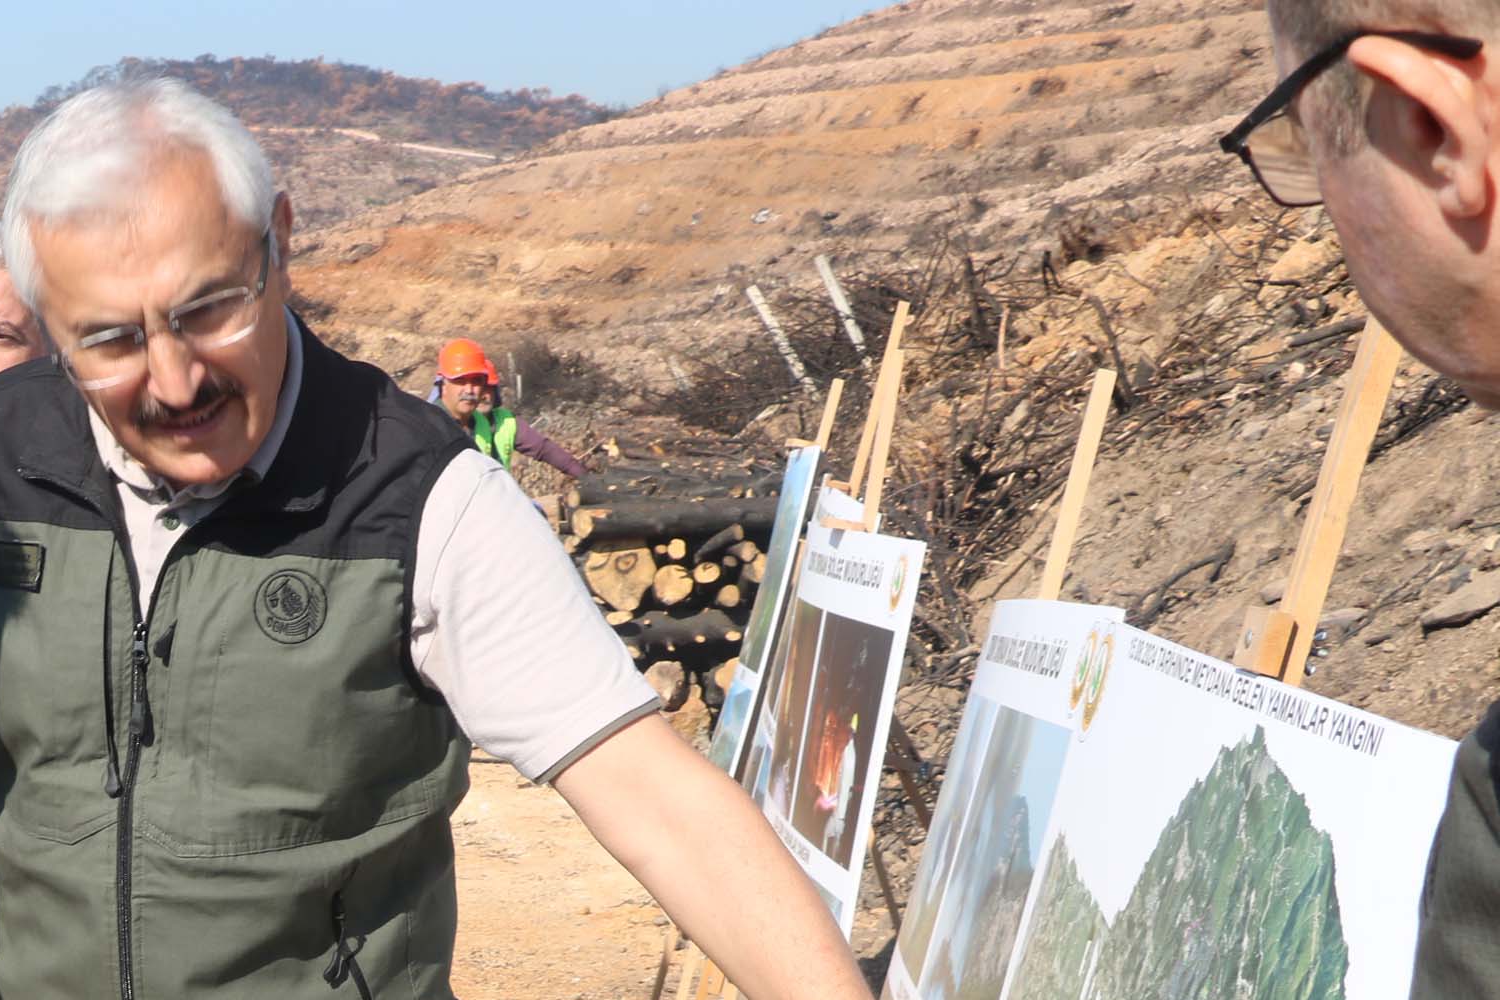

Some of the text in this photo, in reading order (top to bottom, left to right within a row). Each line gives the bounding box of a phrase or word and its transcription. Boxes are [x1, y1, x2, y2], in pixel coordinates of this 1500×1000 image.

[1192, 660, 1234, 699] MEYDANA
[1232, 677, 1268, 712] GELEN
[1266, 688, 1329, 736] YAMANLAR
[1329, 710, 1385, 757] YANGINI
